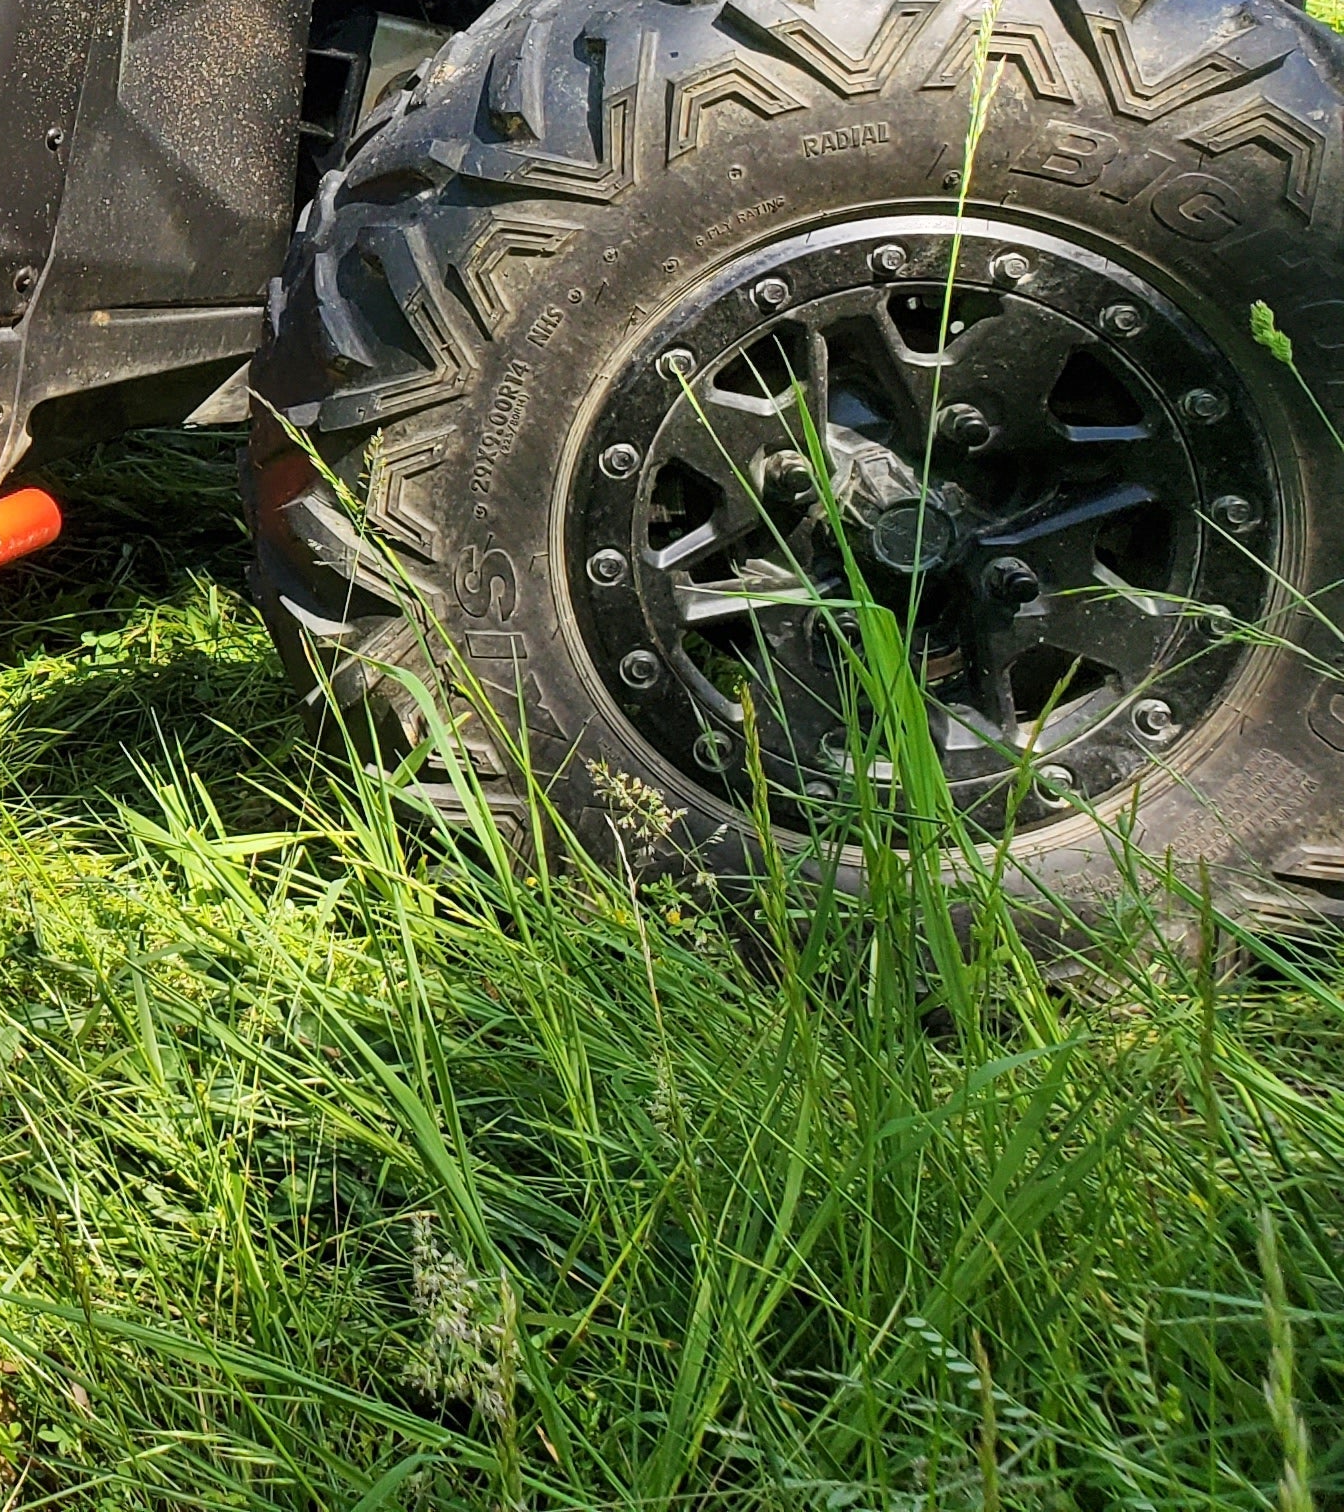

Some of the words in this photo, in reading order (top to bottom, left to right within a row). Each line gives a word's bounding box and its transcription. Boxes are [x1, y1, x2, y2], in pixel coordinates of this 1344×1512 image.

[801, 122, 891, 158] RADIAL
[705, 219, 731, 240] PLY
[734, 194, 784, 224] RATING
[526, 303, 565, 349] NHS
[468, 362, 530, 493] 29X9.00R14
